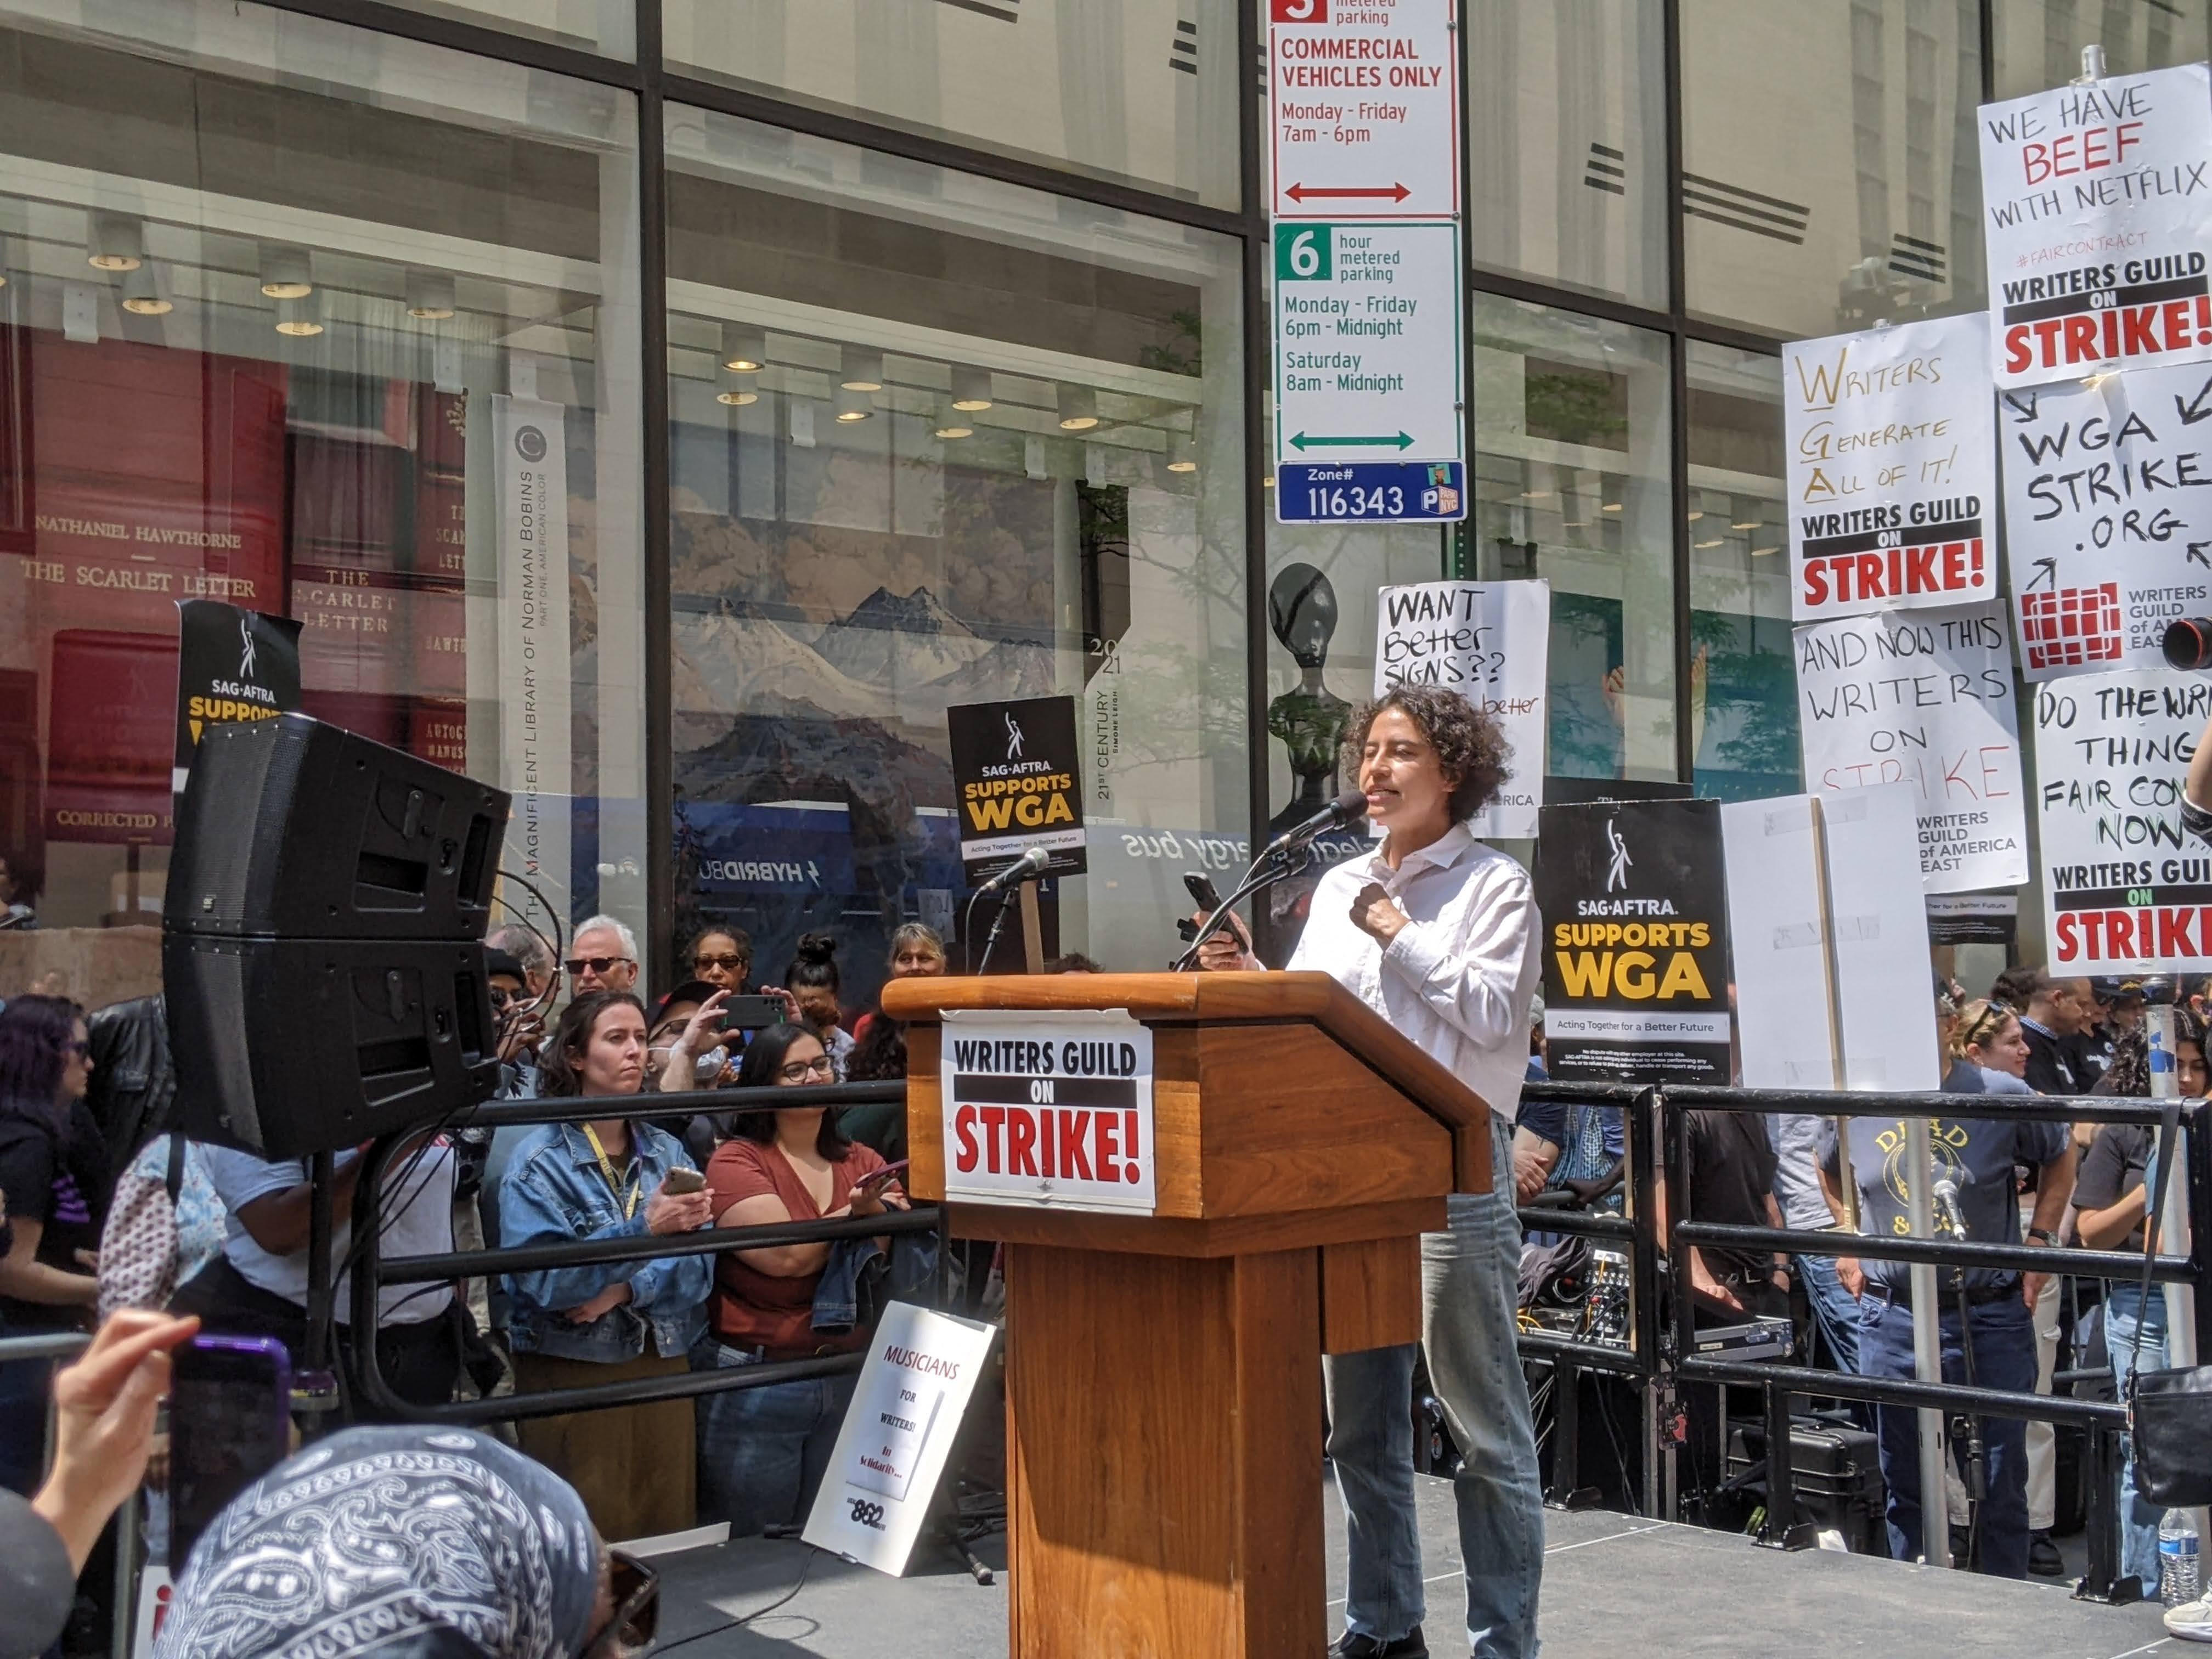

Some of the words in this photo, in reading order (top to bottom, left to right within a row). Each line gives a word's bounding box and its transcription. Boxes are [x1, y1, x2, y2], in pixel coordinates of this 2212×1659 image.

[1336, 10, 1389, 27] parking
[1281, 38, 1419, 59] COMMERCIAL
[1282, 66, 1381, 87] VEHICLES
[1389, 66, 1442, 87] ONLY
[1282, 103, 1342, 123] Monday
[1359, 103, 1407, 123] Friday
[1988, 107, 2046, 144] WE
[2060, 83, 2153, 128] HAVE
[1283, 126, 1316, 142] 7am
[1334, 126, 1370, 145] 6pm
[2023, 122, 2143, 185] BEEF
[1991, 188, 2062, 229] WITH
[2075, 161, 2209, 210] NETFLIX
[1290, 230, 1319, 276] 6
[1340, 235, 1372, 249] hour
[2016, 232, 2149, 268] #FAIRCONTRACT
[1340, 251, 1400, 264] metered
[1341, 268, 1393, 284] parking
[2002, 263, 2116, 304] WRITERS
[2124, 251, 2205, 281] GUILD
[1285, 296, 1349, 317] Monday
[1367, 296, 1417, 316] Friday
[2089, 291, 2117, 308] ON
[1285, 319, 1321, 338] 6pm
[1337, 318, 1403, 339] Midnight
[2005, 295, 2212, 374] STRIKE!
[1286, 352, 1361, 372] Saturday
[1286, 374, 1321, 391] 8am
[1338, 374, 1403, 394] Midnight
[2018, 411, 2159, 466] WGA
[1308, 469, 1353, 481] Zone#
[1877, 465, 1907, 487] OF
[1920, 444, 1957, 484] IT!
[537, 473, 546, 511] COLOR
[2028, 452, 2212, 521] STRIKE
[520, 471, 533, 541] BOBINS
[1309, 486, 1404, 516] 116343
[1440, 499, 1458, 511] NYC
[1801, 504, 1901, 538] WRITERS
[1909, 495, 1980, 523] GUILD
[36, 516, 129, 539] NATHANIEL
[136, 527, 241, 549] HAWTHORNE
[539, 513, 548, 568] AMERICAN
[1878, 530, 1901, 547] ON
[2076, 508, 2189, 551] .ORG
[21, 560, 65, 583] THE
[76, 566, 172, 591] SCARLET
[183, 575, 256, 597] LETTER
[326, 569, 369, 586] THE
[1804, 538, 1984, 606] STRIKE!
[522, 548, 535, 628] NORMAN
[2129, 585, 2207, 603] WRITERS
[1388, 589, 1486, 629] WANT
[2130, 603, 2184, 618] GUILD
[303, 612, 388, 632] LETTER
[2130, 620, 2148, 634] of
[523, 636, 535, 659] OF
[1090, 638, 1117, 657] 20
[1802, 632, 1865, 674] AND
[1876, 625, 1934, 660] NOW
[1940, 618, 2002, 650] THIS
[2131, 635, 2165, 648] EAS
[1103, 655, 1120, 674] 21
[524, 665, 537, 742] LIBRARY
[1482, 693, 1539, 716] better
[1808, 670, 2006, 721] WRITERS
[2039, 692, 2076, 729] DO
[2095, 686, 2159, 720] THE
[189, 696, 281, 722] SUPPO
[1097, 690, 1109, 768] CENTURY
[1870, 726, 1927, 752] ON
[2075, 731, 2196, 767] THING
[965, 773, 1071, 799] SUPPORTS
[2044, 779, 2121, 814] FAIR
[526, 748, 538, 875] MAGNIFICENT
[967, 792, 1074, 831] WGA
[1498, 795, 1534, 806] RICA
[56, 810, 157, 828] CORRECTED
[1916, 811, 1989, 829] WRITERS
[992, 843, 1022, 851] Together
[1918, 828, 1968, 843] GUILD
[1920, 845, 1934, 858] of
[1939, 838, 2017, 857] AMERICA
[1921, 858, 1962, 873] EAST
[2052, 860, 2152, 890] WRITERS
[2128, 889, 2152, 906] ON
[1555, 923, 1711, 947] SUPPORTS
[1555, 951, 1712, 1000] WGA
[1558, 1020, 1585, 1030] Acting
[1587, 1020, 1619, 1031] Together
[1621, 1022, 1633, 1030] for
[1645, 1023, 1677, 1031] Better
[1680, 1023, 1714, 1032] Future
[954, 1040, 1054, 1074] WRITERS
[1063, 1041, 1136, 1076] GUILD
[1031, 1080, 1054, 1104] ON
[955, 1104, 1141, 1184] STRIKE!
[883, 1345, 960, 1380] MUSICIANS
[899, 1390, 917, 1403] FOR
[881, 1412, 916, 1432] WRITERS!
